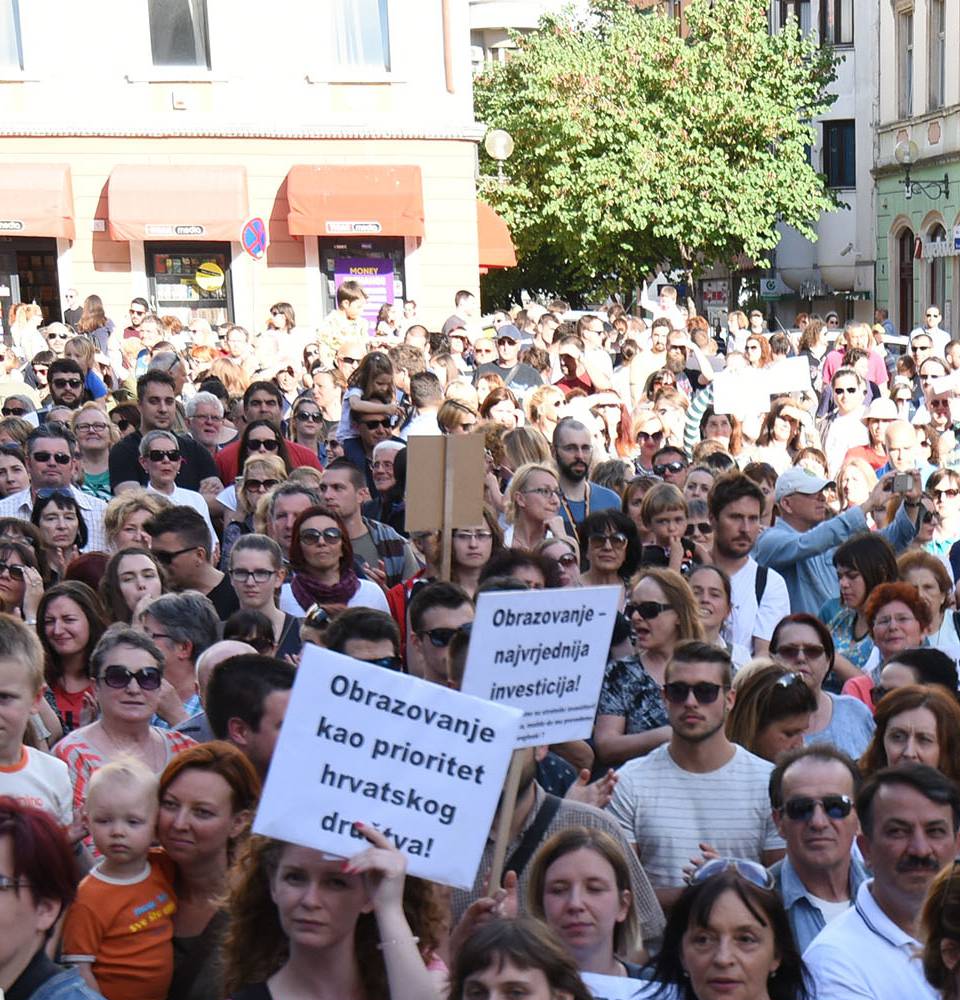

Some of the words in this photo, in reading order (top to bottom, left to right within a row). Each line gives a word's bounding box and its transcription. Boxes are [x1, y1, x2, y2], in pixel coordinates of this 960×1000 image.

[349, 266, 379, 276] MONEY
[492, 604, 595, 628] Obrazovanje
[493, 640, 590, 668] najvrjednija
[489, 674, 582, 701] investicija!
[330, 674, 496, 744] Obrazovanje
[316, 716, 365, 748] kao
[371, 738, 486, 785] prioritet
[319, 763, 457, 826] hrvatskog
